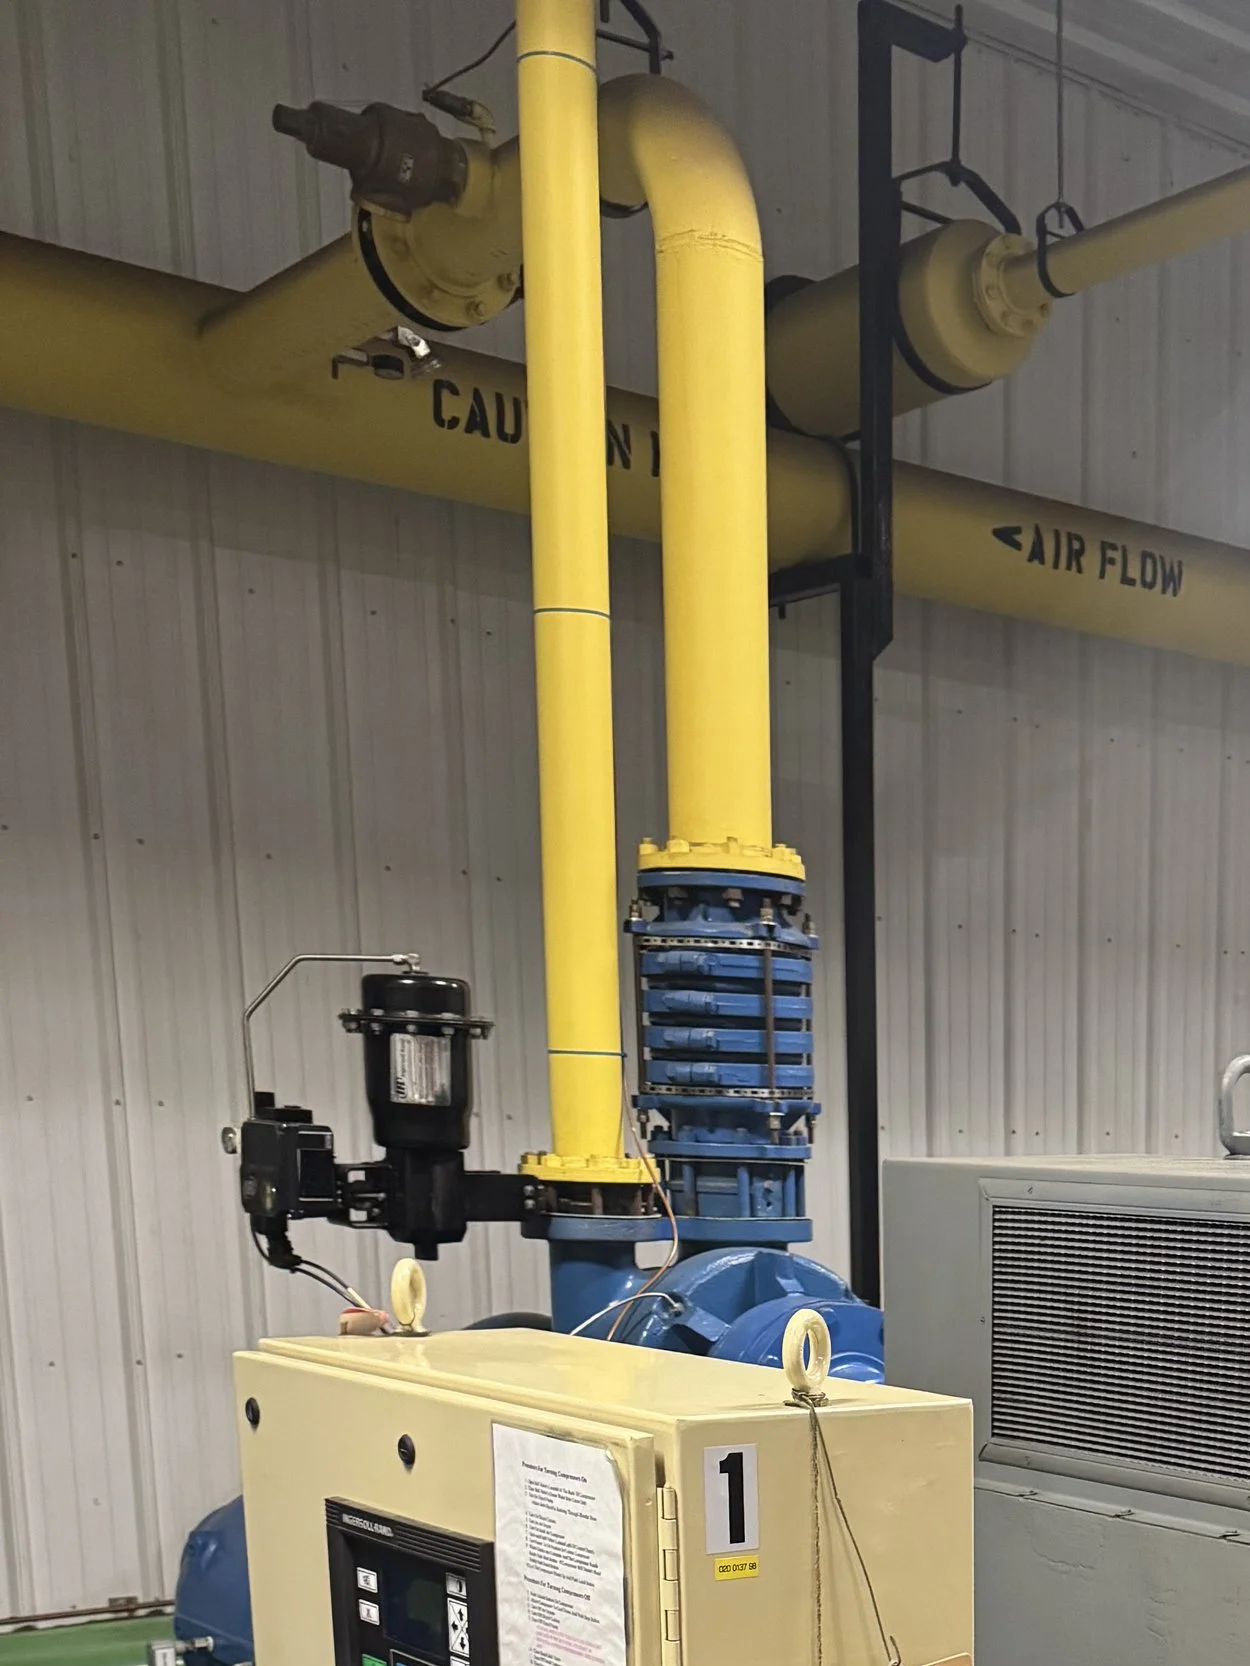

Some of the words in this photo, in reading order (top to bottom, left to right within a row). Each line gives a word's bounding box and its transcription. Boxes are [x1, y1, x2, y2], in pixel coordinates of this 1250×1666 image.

[431, 378, 632, 470] CAUN
[1027, 523, 1087, 575] AIR
[1098, 540, 1185, 599] FLOW
[719, 1452, 746, 1545] 1
[732, 1563, 748, 1573] 0137
